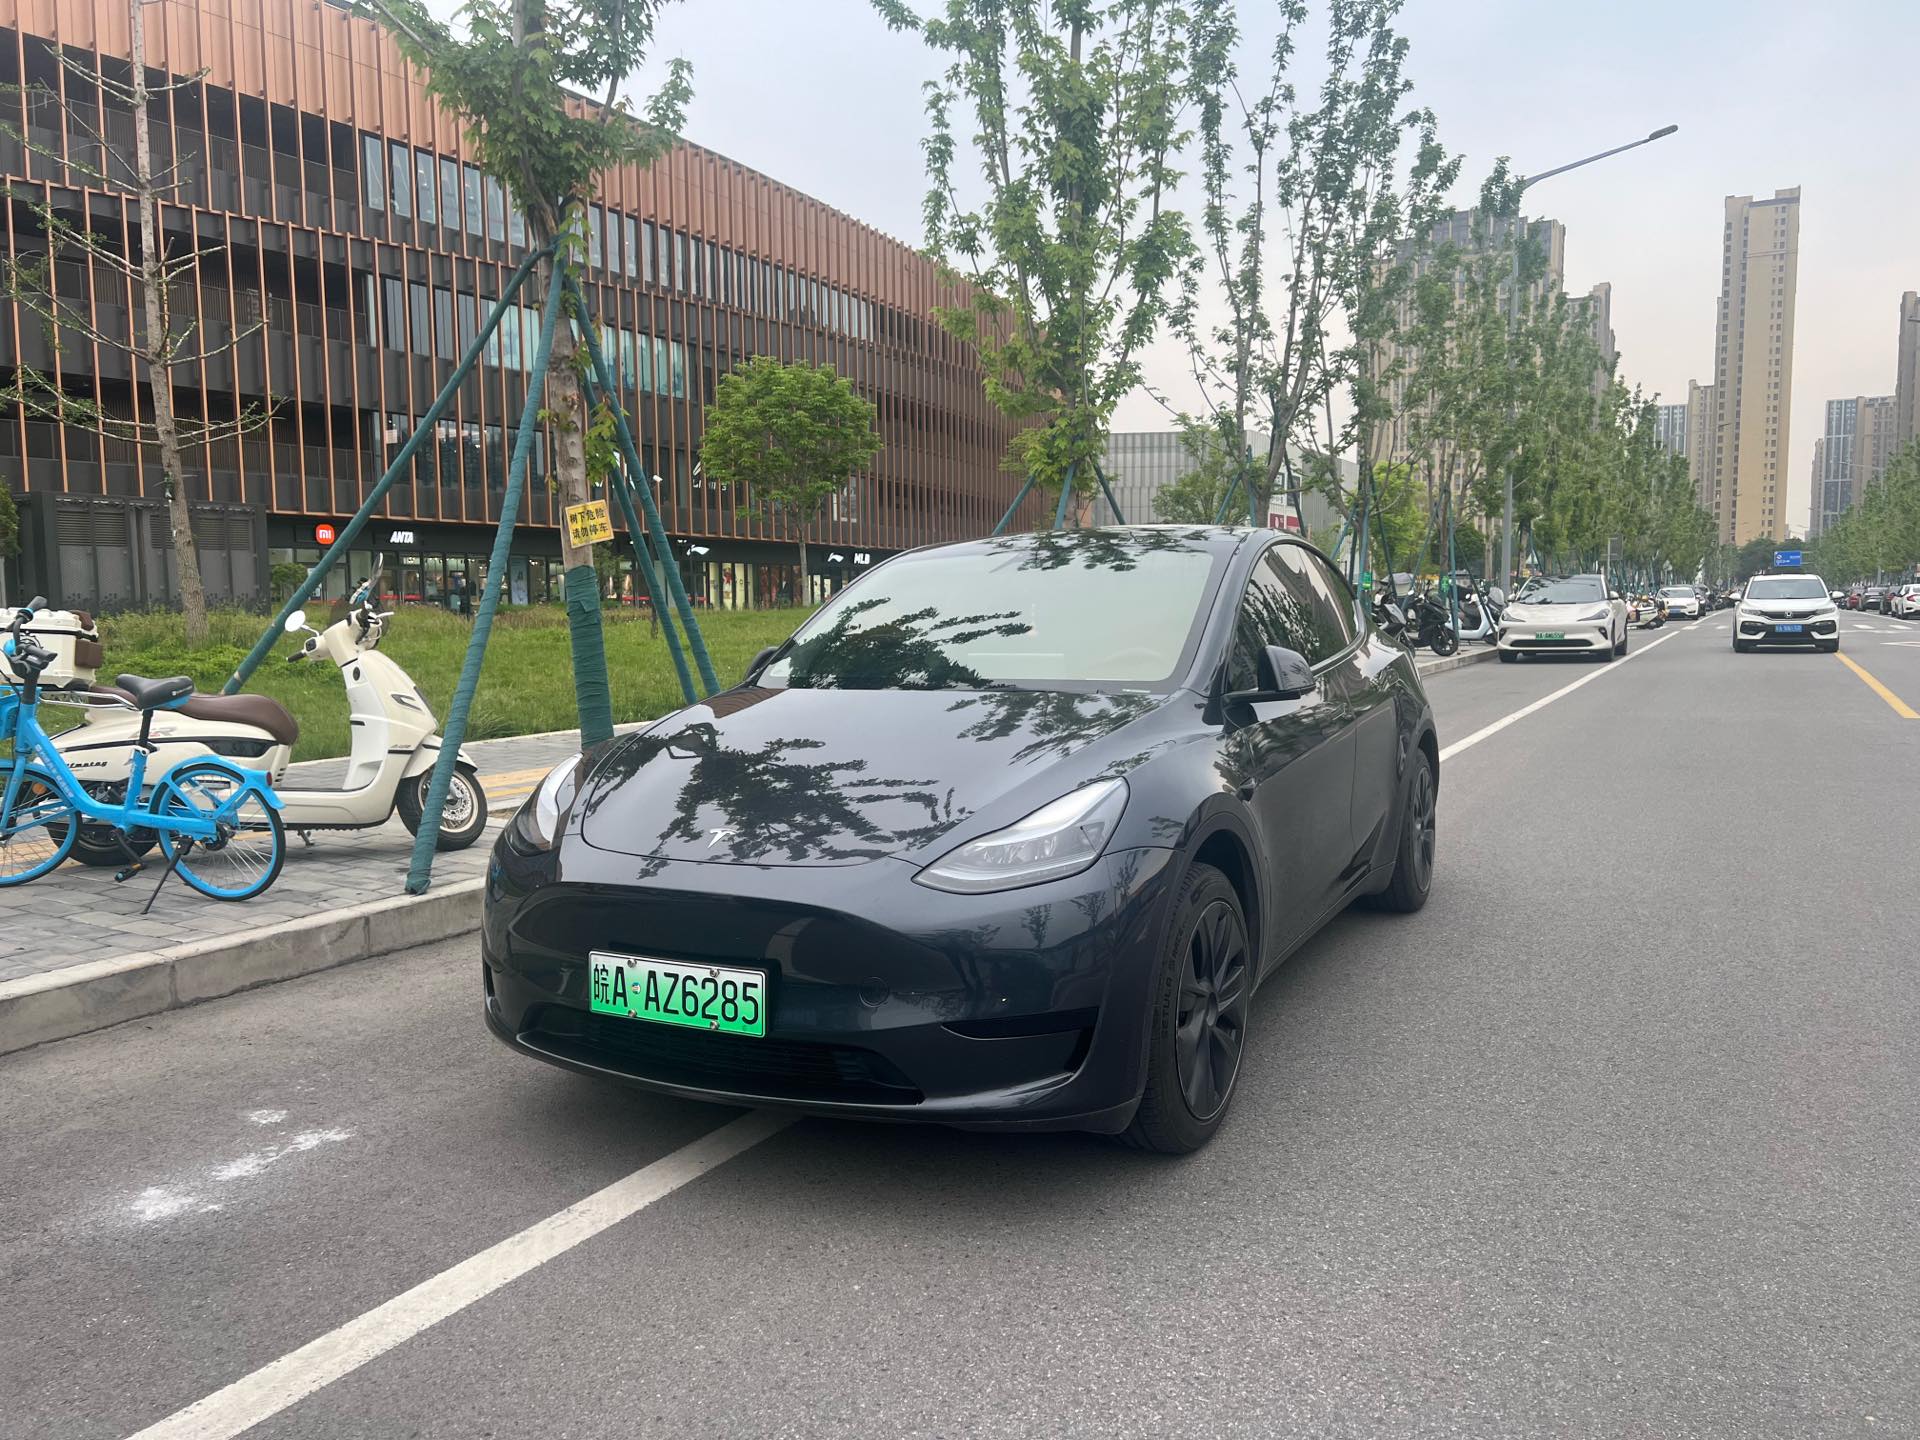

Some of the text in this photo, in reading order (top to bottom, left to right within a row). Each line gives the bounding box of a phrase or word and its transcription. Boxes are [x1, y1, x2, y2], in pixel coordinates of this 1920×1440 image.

[570, 508, 606, 524] 树下危险
[390, 531, 414, 544] ANTA
[572, 523, 609, 539] 请勿停车
[853, 552, 870, 565] MLB
